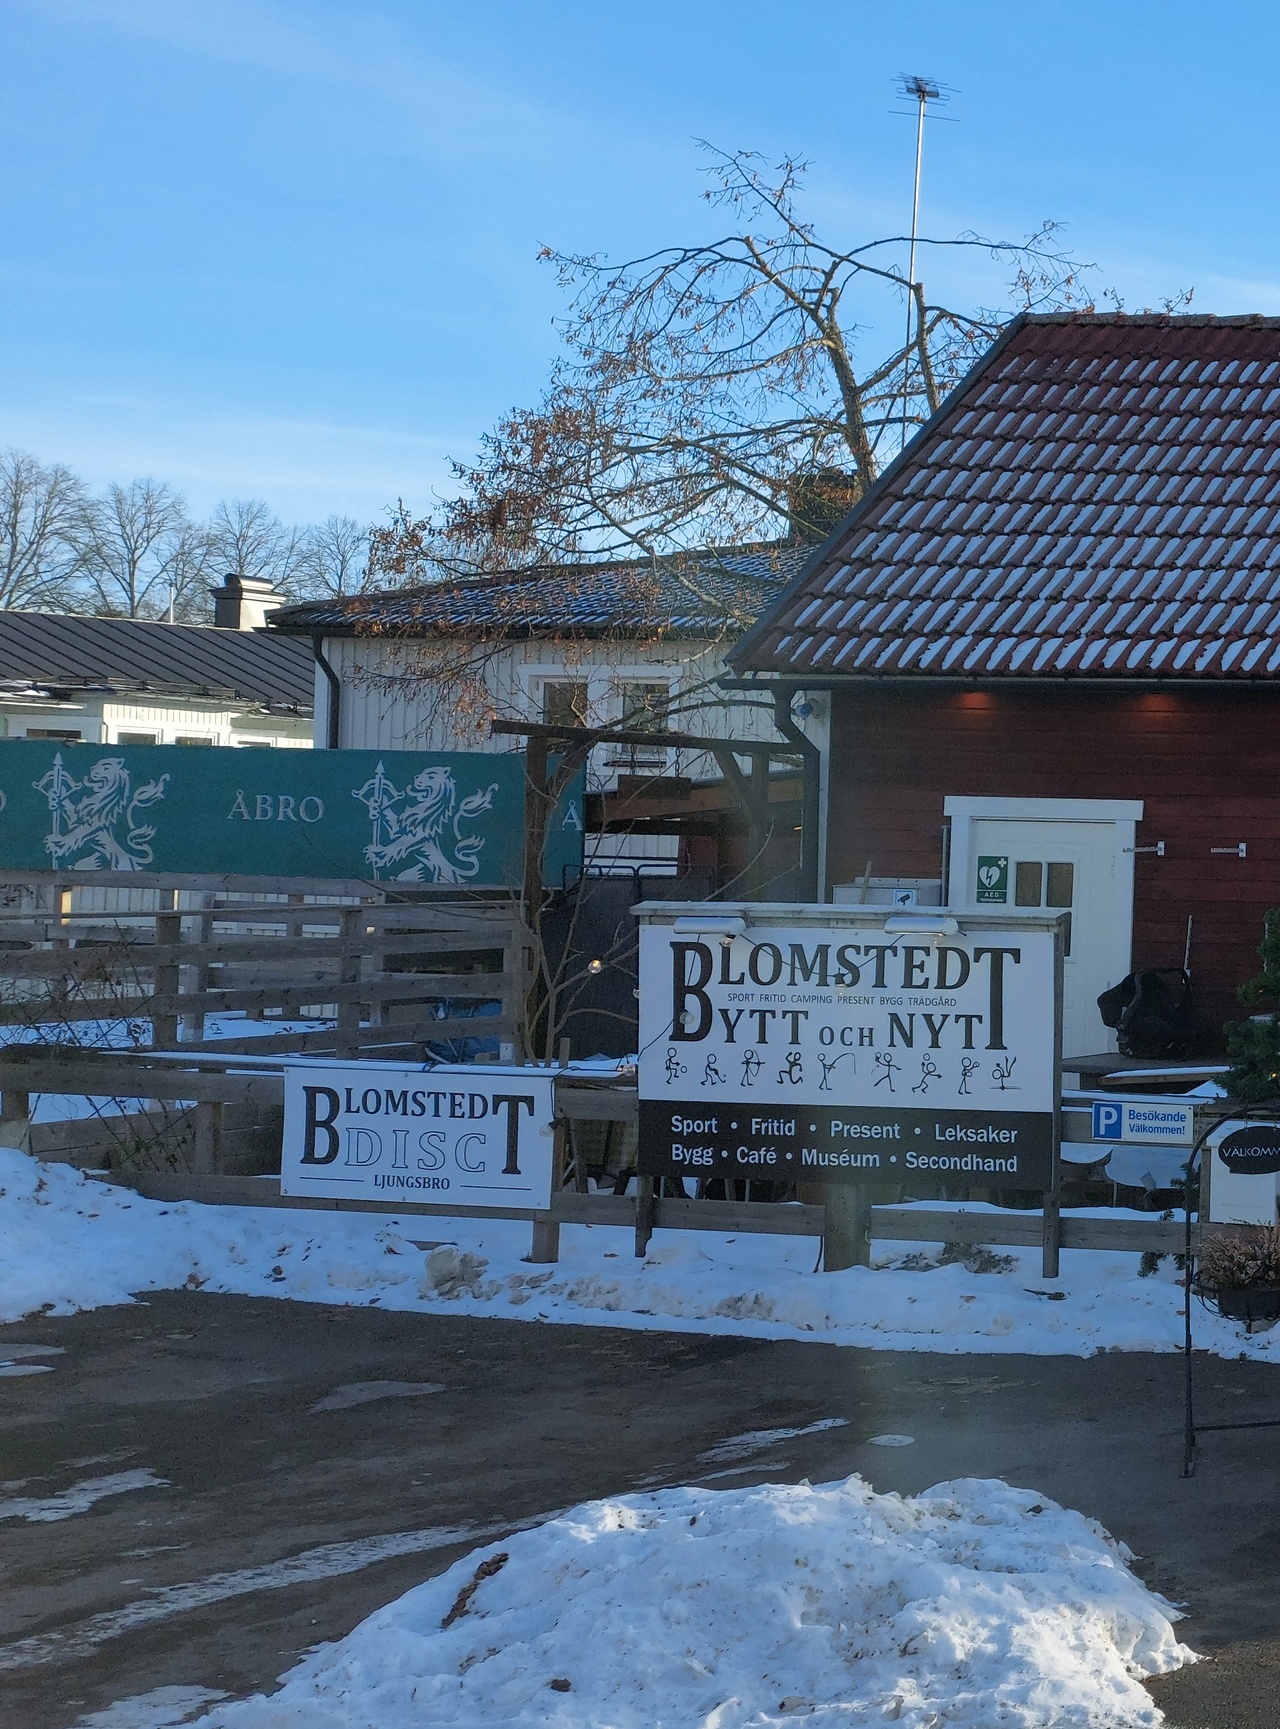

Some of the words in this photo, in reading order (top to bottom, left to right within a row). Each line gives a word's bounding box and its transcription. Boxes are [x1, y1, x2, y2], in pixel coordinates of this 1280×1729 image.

[226, 789, 325, 823] ÅBRO
[669, 941, 1021, 1050] BLOMSTEDT
[727, 993, 755, 1003] SPORT
[759, 993, 787, 1004] FRITID
[790, 994, 832, 1005] CAMPING
[837, 995, 875, 1006] PRESENT
[879, 996, 903, 1007] BYGG
[908, 995, 957, 1007] TRÄDGÅRD
[818, 1026, 875, 1048] OCH
[300, 1085, 535, 1175] BLOMSTEDT
[671, 1115, 718, 1138] Sport
[751, 1117, 795, 1136] Fritid
[831, 1120, 900, 1139] Present
[935, 1123, 1018, 1143] Leksaker
[1100, 1106, 1118, 1135] P
[1128, 1109, 1187, 1123] Besökande
[1129, 1122, 1186, 1135] Välkommen!
[344, 1127, 487, 1173] DISC
[671, 1144, 713, 1166] Bygg
[736, 1146, 777, 1165] Café
[801, 1148, 880, 1168] Muséum
[905, 1152, 1018, 1172] Secondhand
[374, 1174, 450, 1190] LJUNGSBRO
